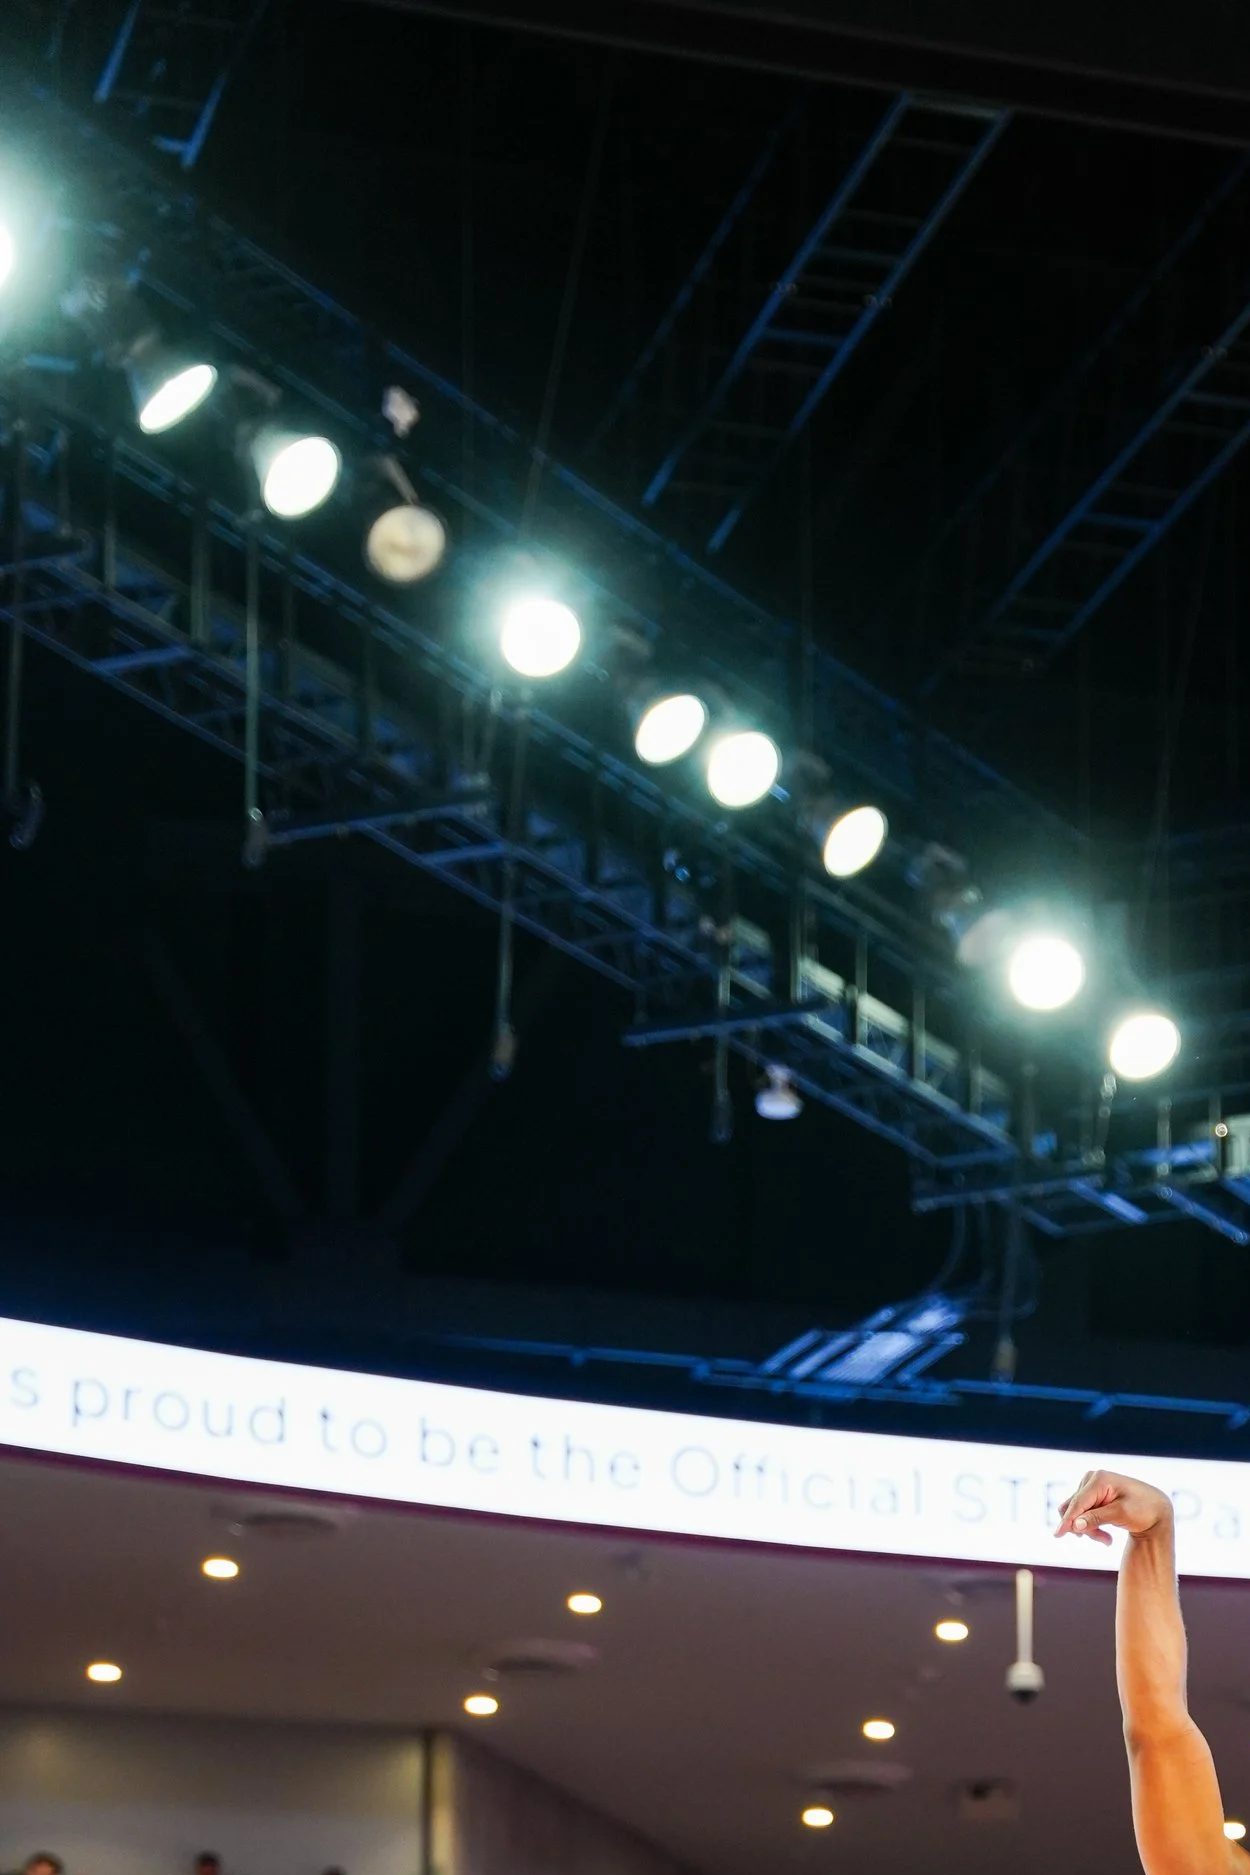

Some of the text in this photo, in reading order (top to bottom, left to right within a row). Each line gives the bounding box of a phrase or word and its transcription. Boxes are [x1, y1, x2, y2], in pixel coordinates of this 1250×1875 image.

[72, 1377, 287, 1444] proud
[318, 1403, 389, 1460] to
[419, 1415, 501, 1475] be
[530, 1432, 641, 1490] the
[671, 1444, 923, 1516] Official
[952, 1471, 1075, 1528] STE
